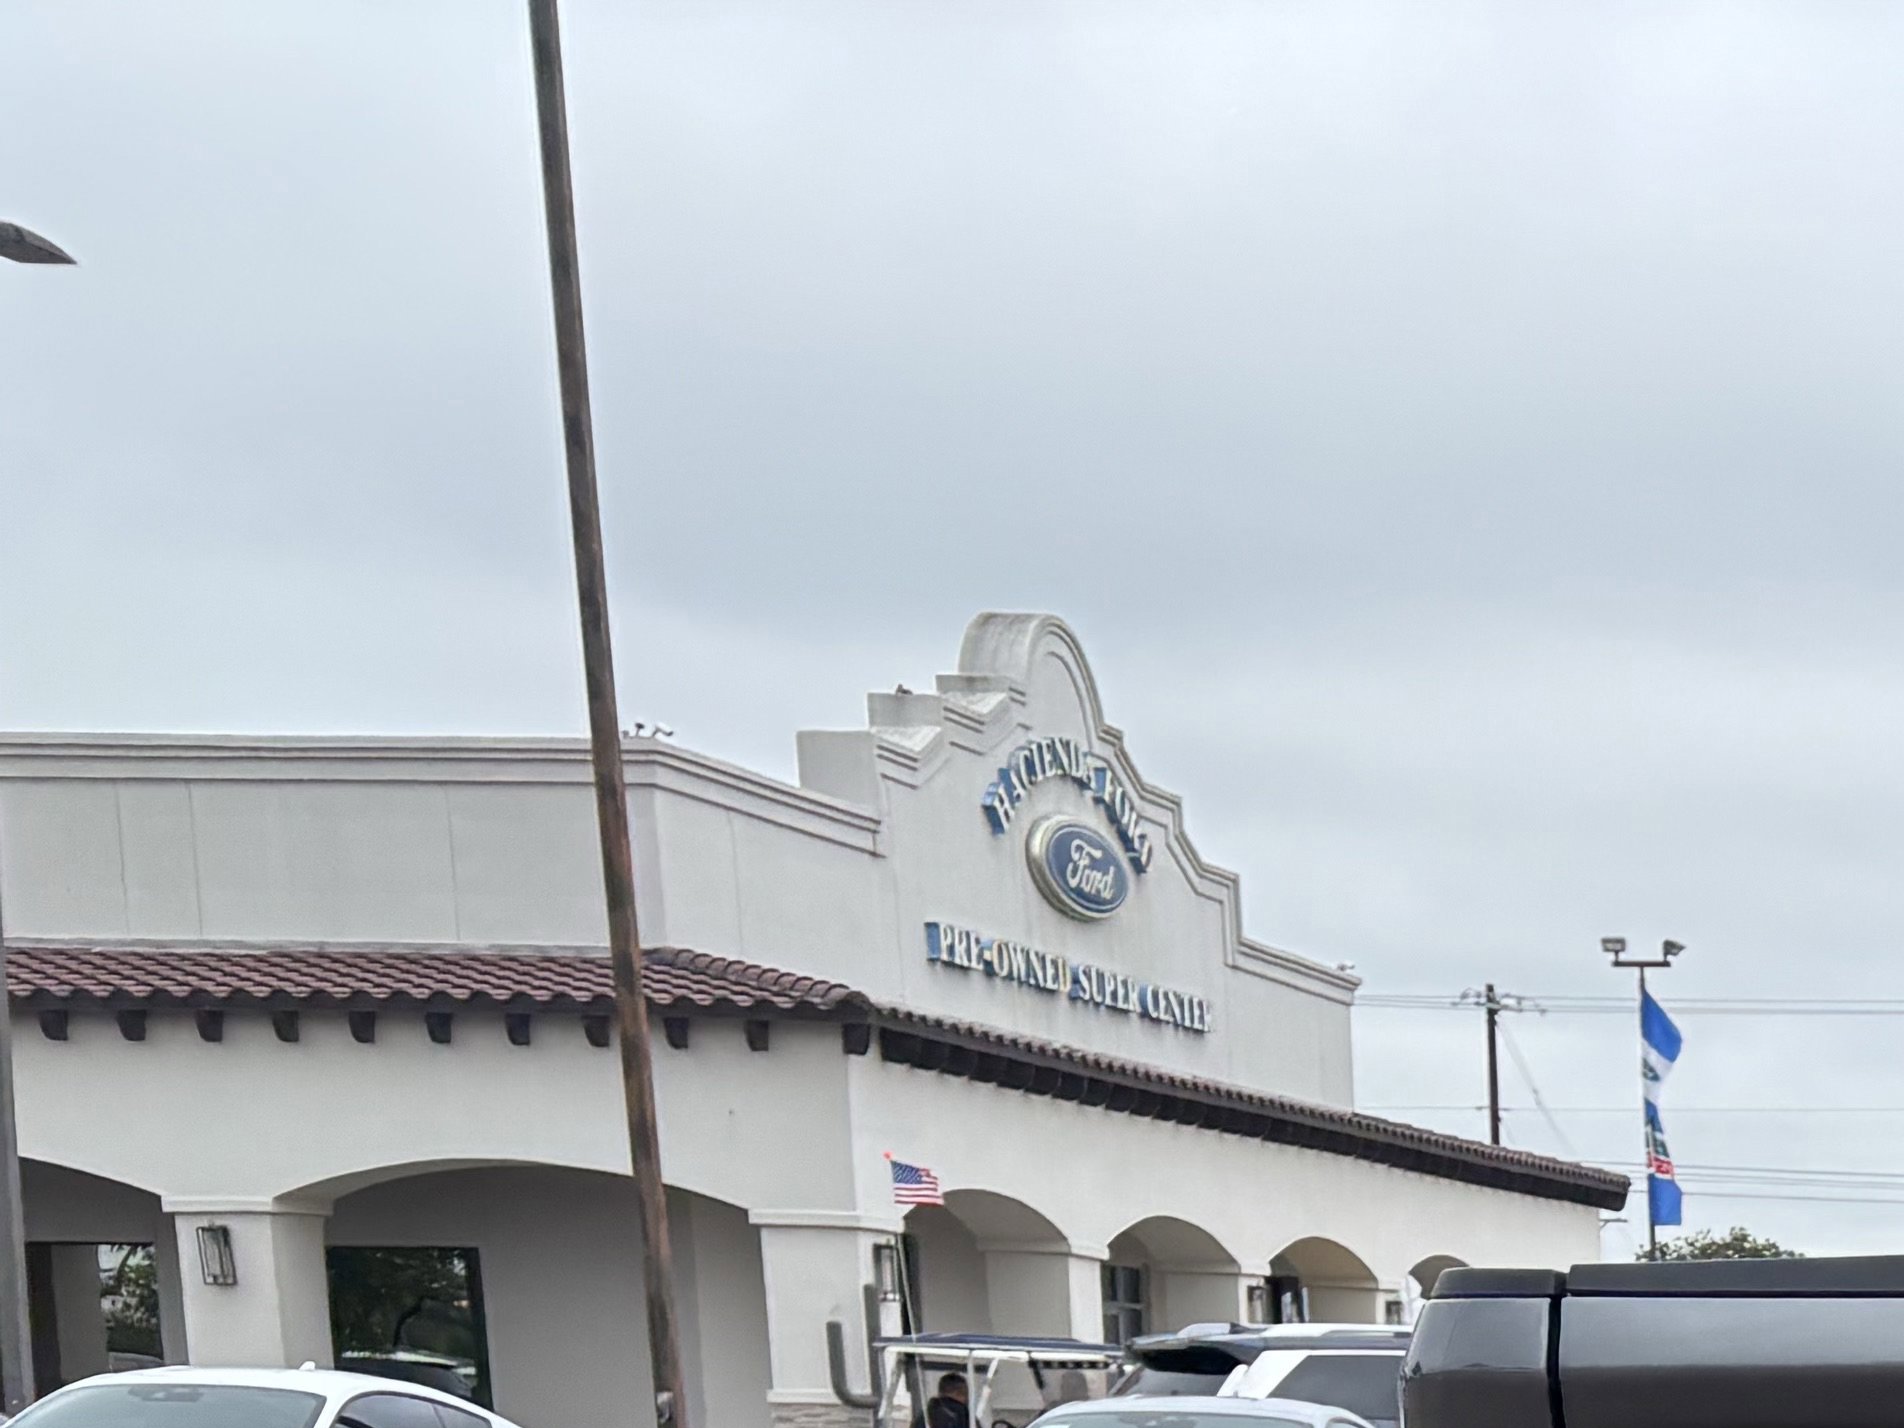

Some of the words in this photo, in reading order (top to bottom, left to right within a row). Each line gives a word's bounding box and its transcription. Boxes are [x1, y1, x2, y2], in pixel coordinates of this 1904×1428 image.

[1065, 838, 1115, 900] Ford
[936, 923, 1072, 994] PRE-OWNED
[1078, 963, 1142, 1014] SUPER
